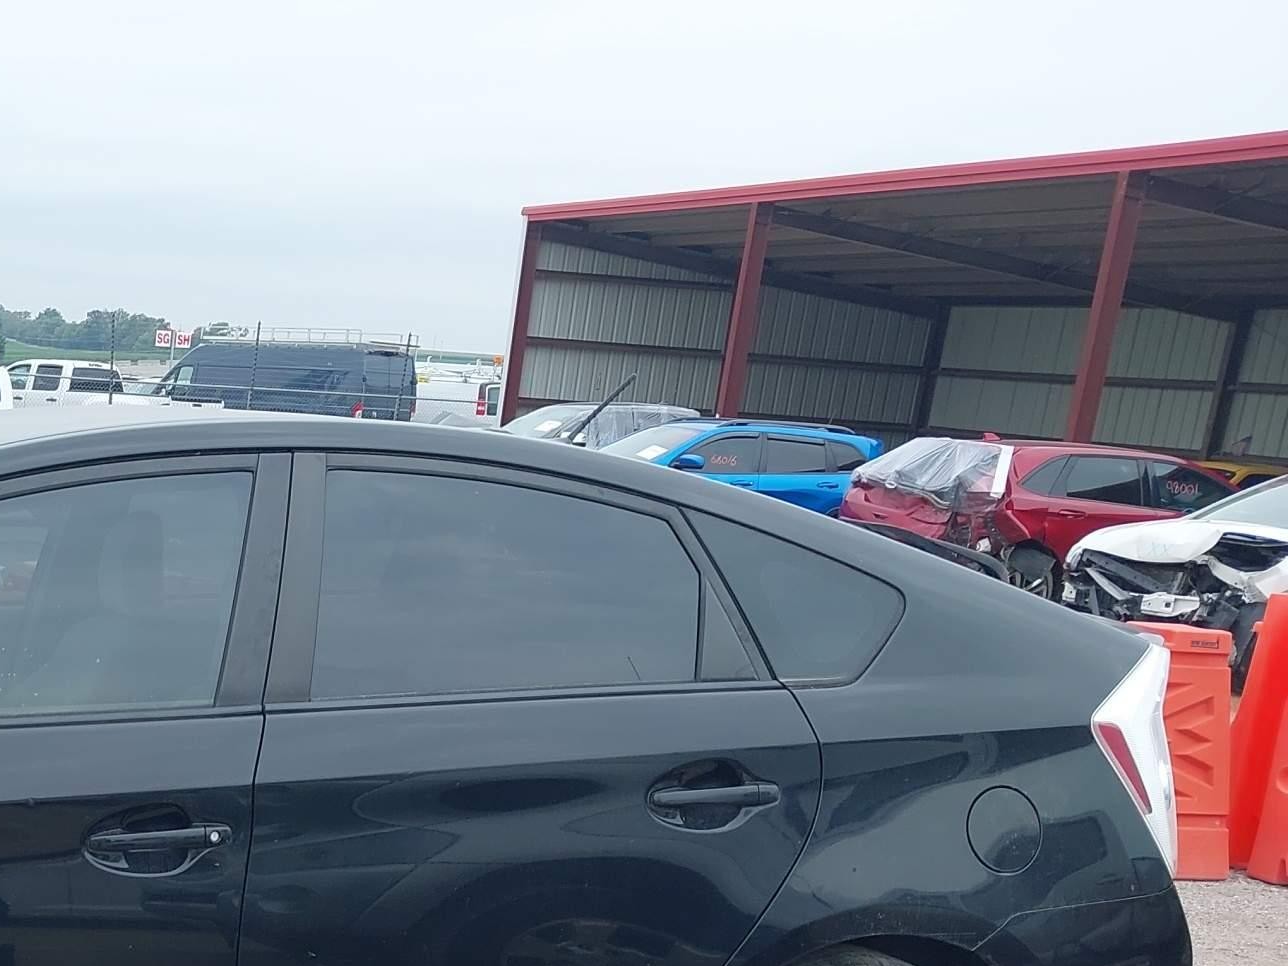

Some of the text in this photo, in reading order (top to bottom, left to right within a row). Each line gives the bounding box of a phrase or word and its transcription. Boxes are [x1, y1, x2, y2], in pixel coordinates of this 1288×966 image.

[157, 332, 171, 344] SG
[177, 334, 191, 346] SH
[1166, 480, 1199, 496] 98001
